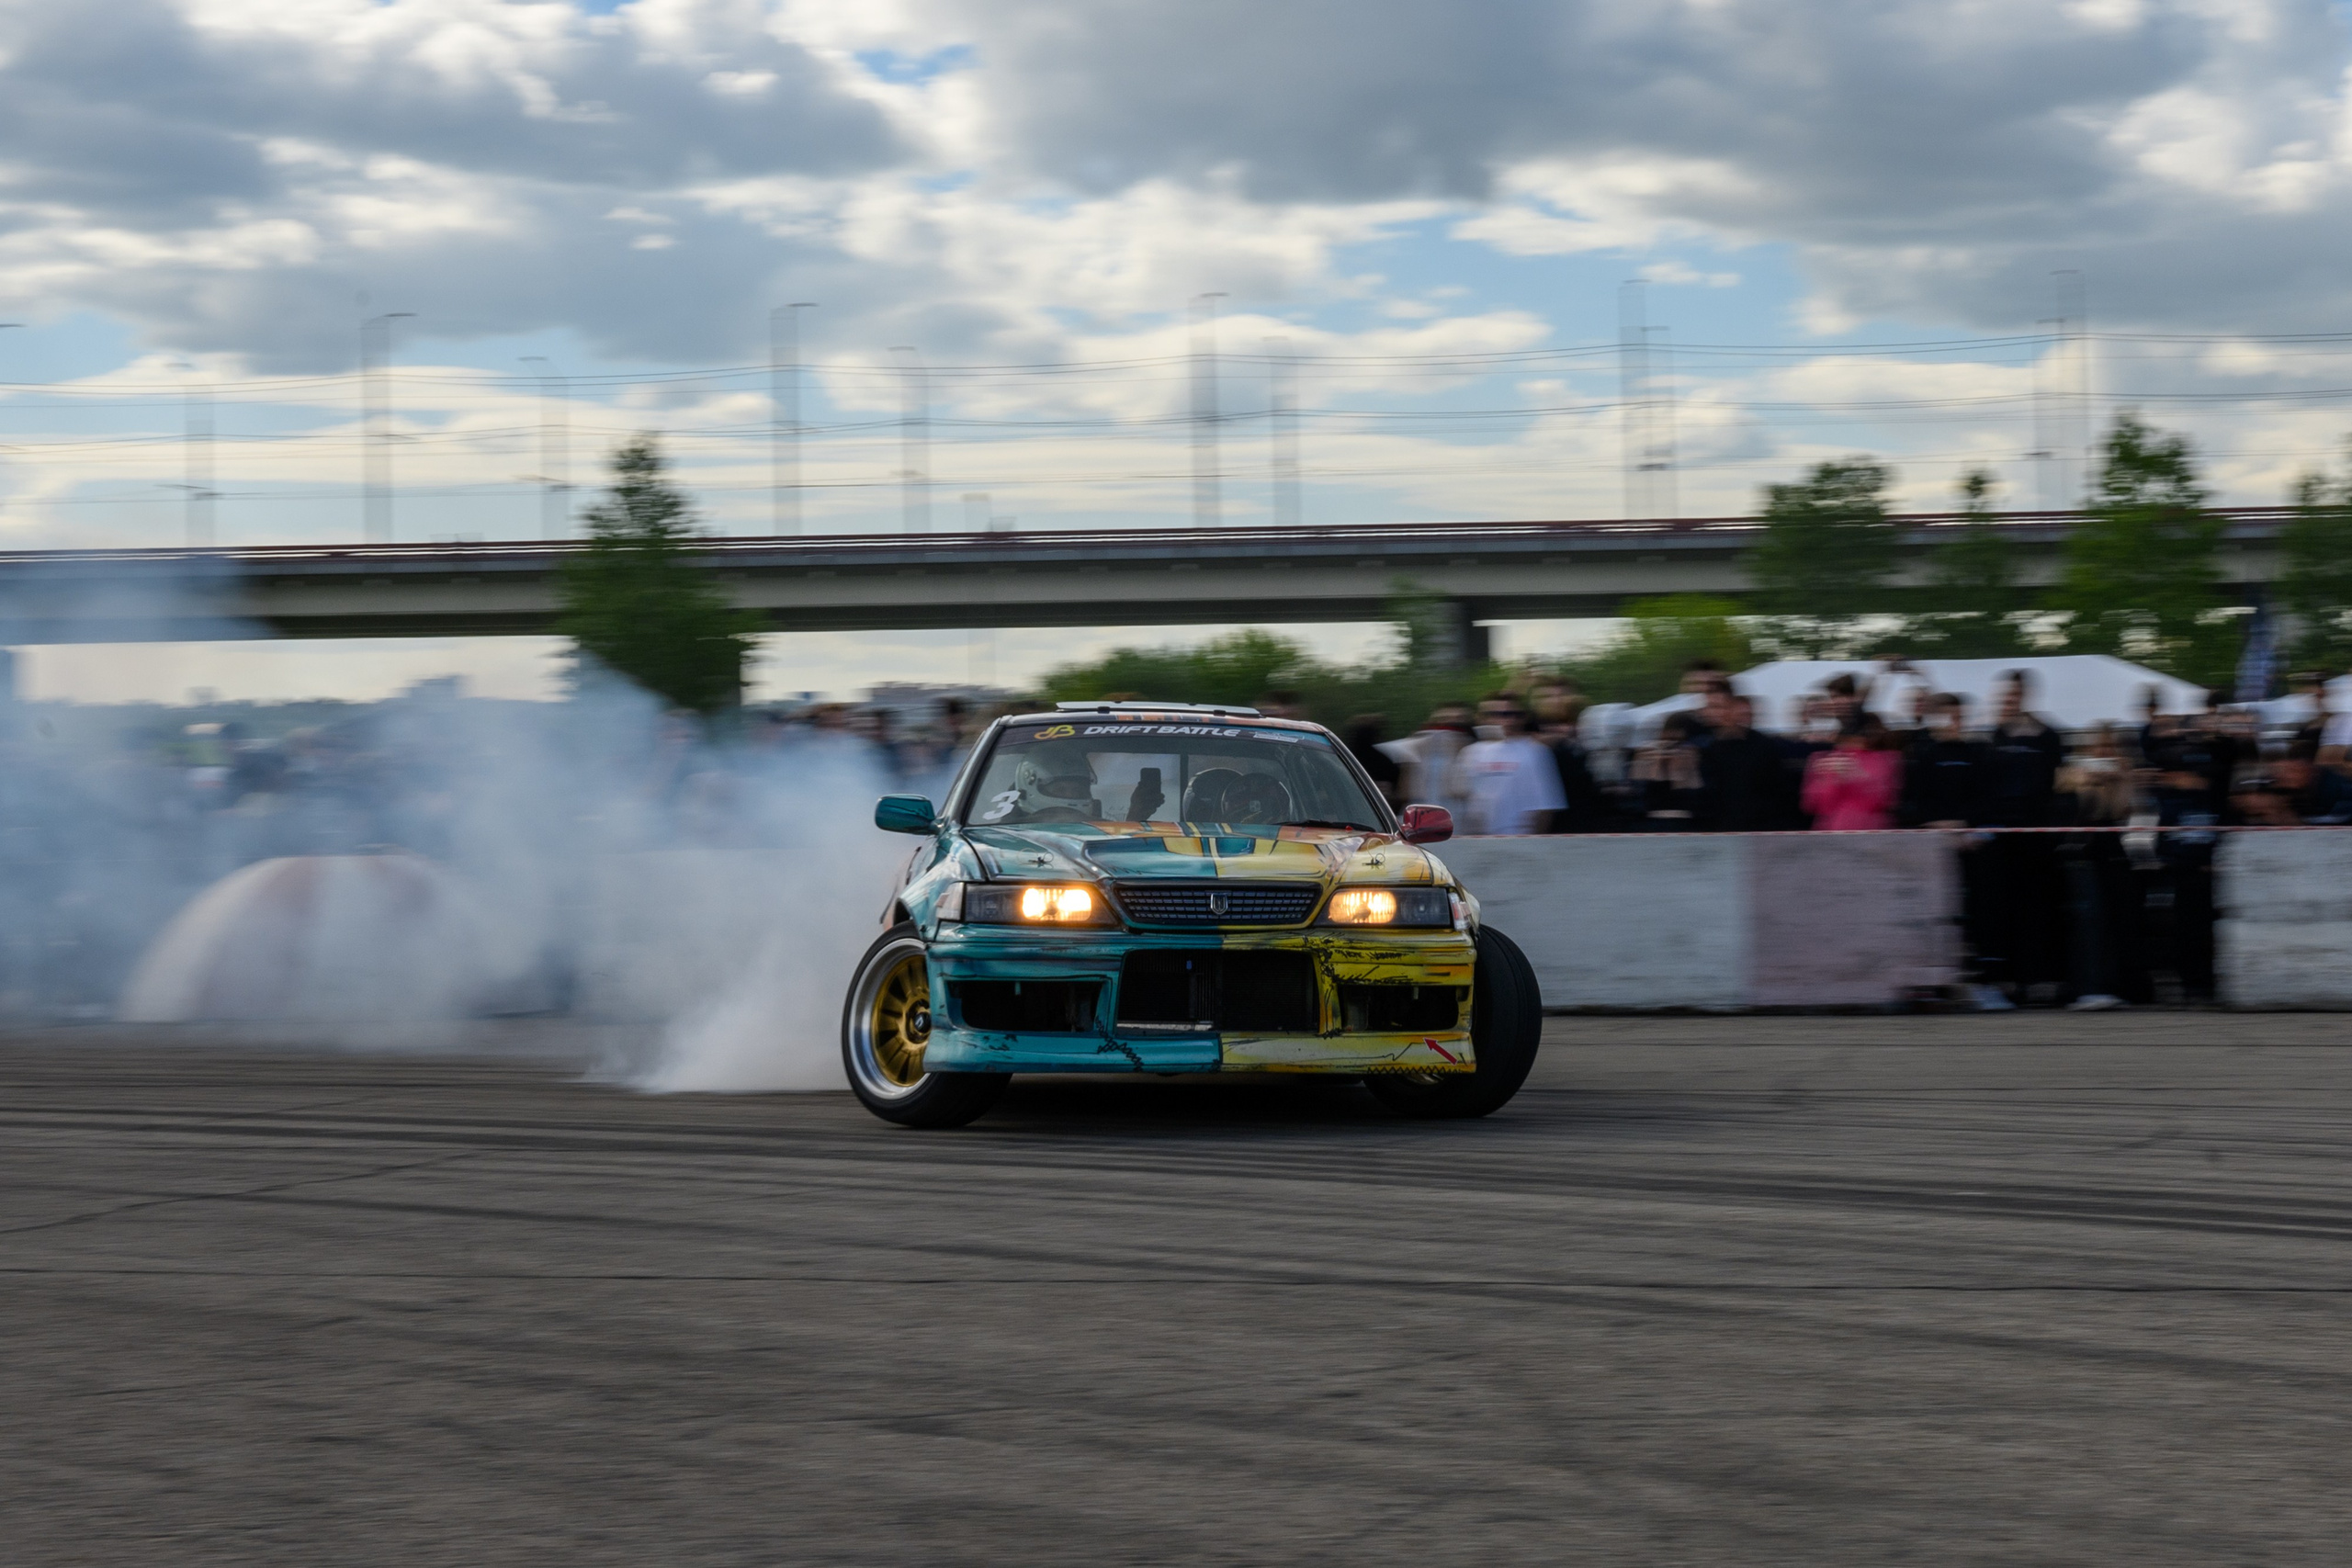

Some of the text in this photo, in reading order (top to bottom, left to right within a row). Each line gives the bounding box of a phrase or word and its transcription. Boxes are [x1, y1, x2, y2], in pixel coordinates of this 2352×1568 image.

[1083, 726, 1158, 735] DRIFT
[1157, 726, 1241, 737] BATTLE
[982, 790, 1021, 820] 3
